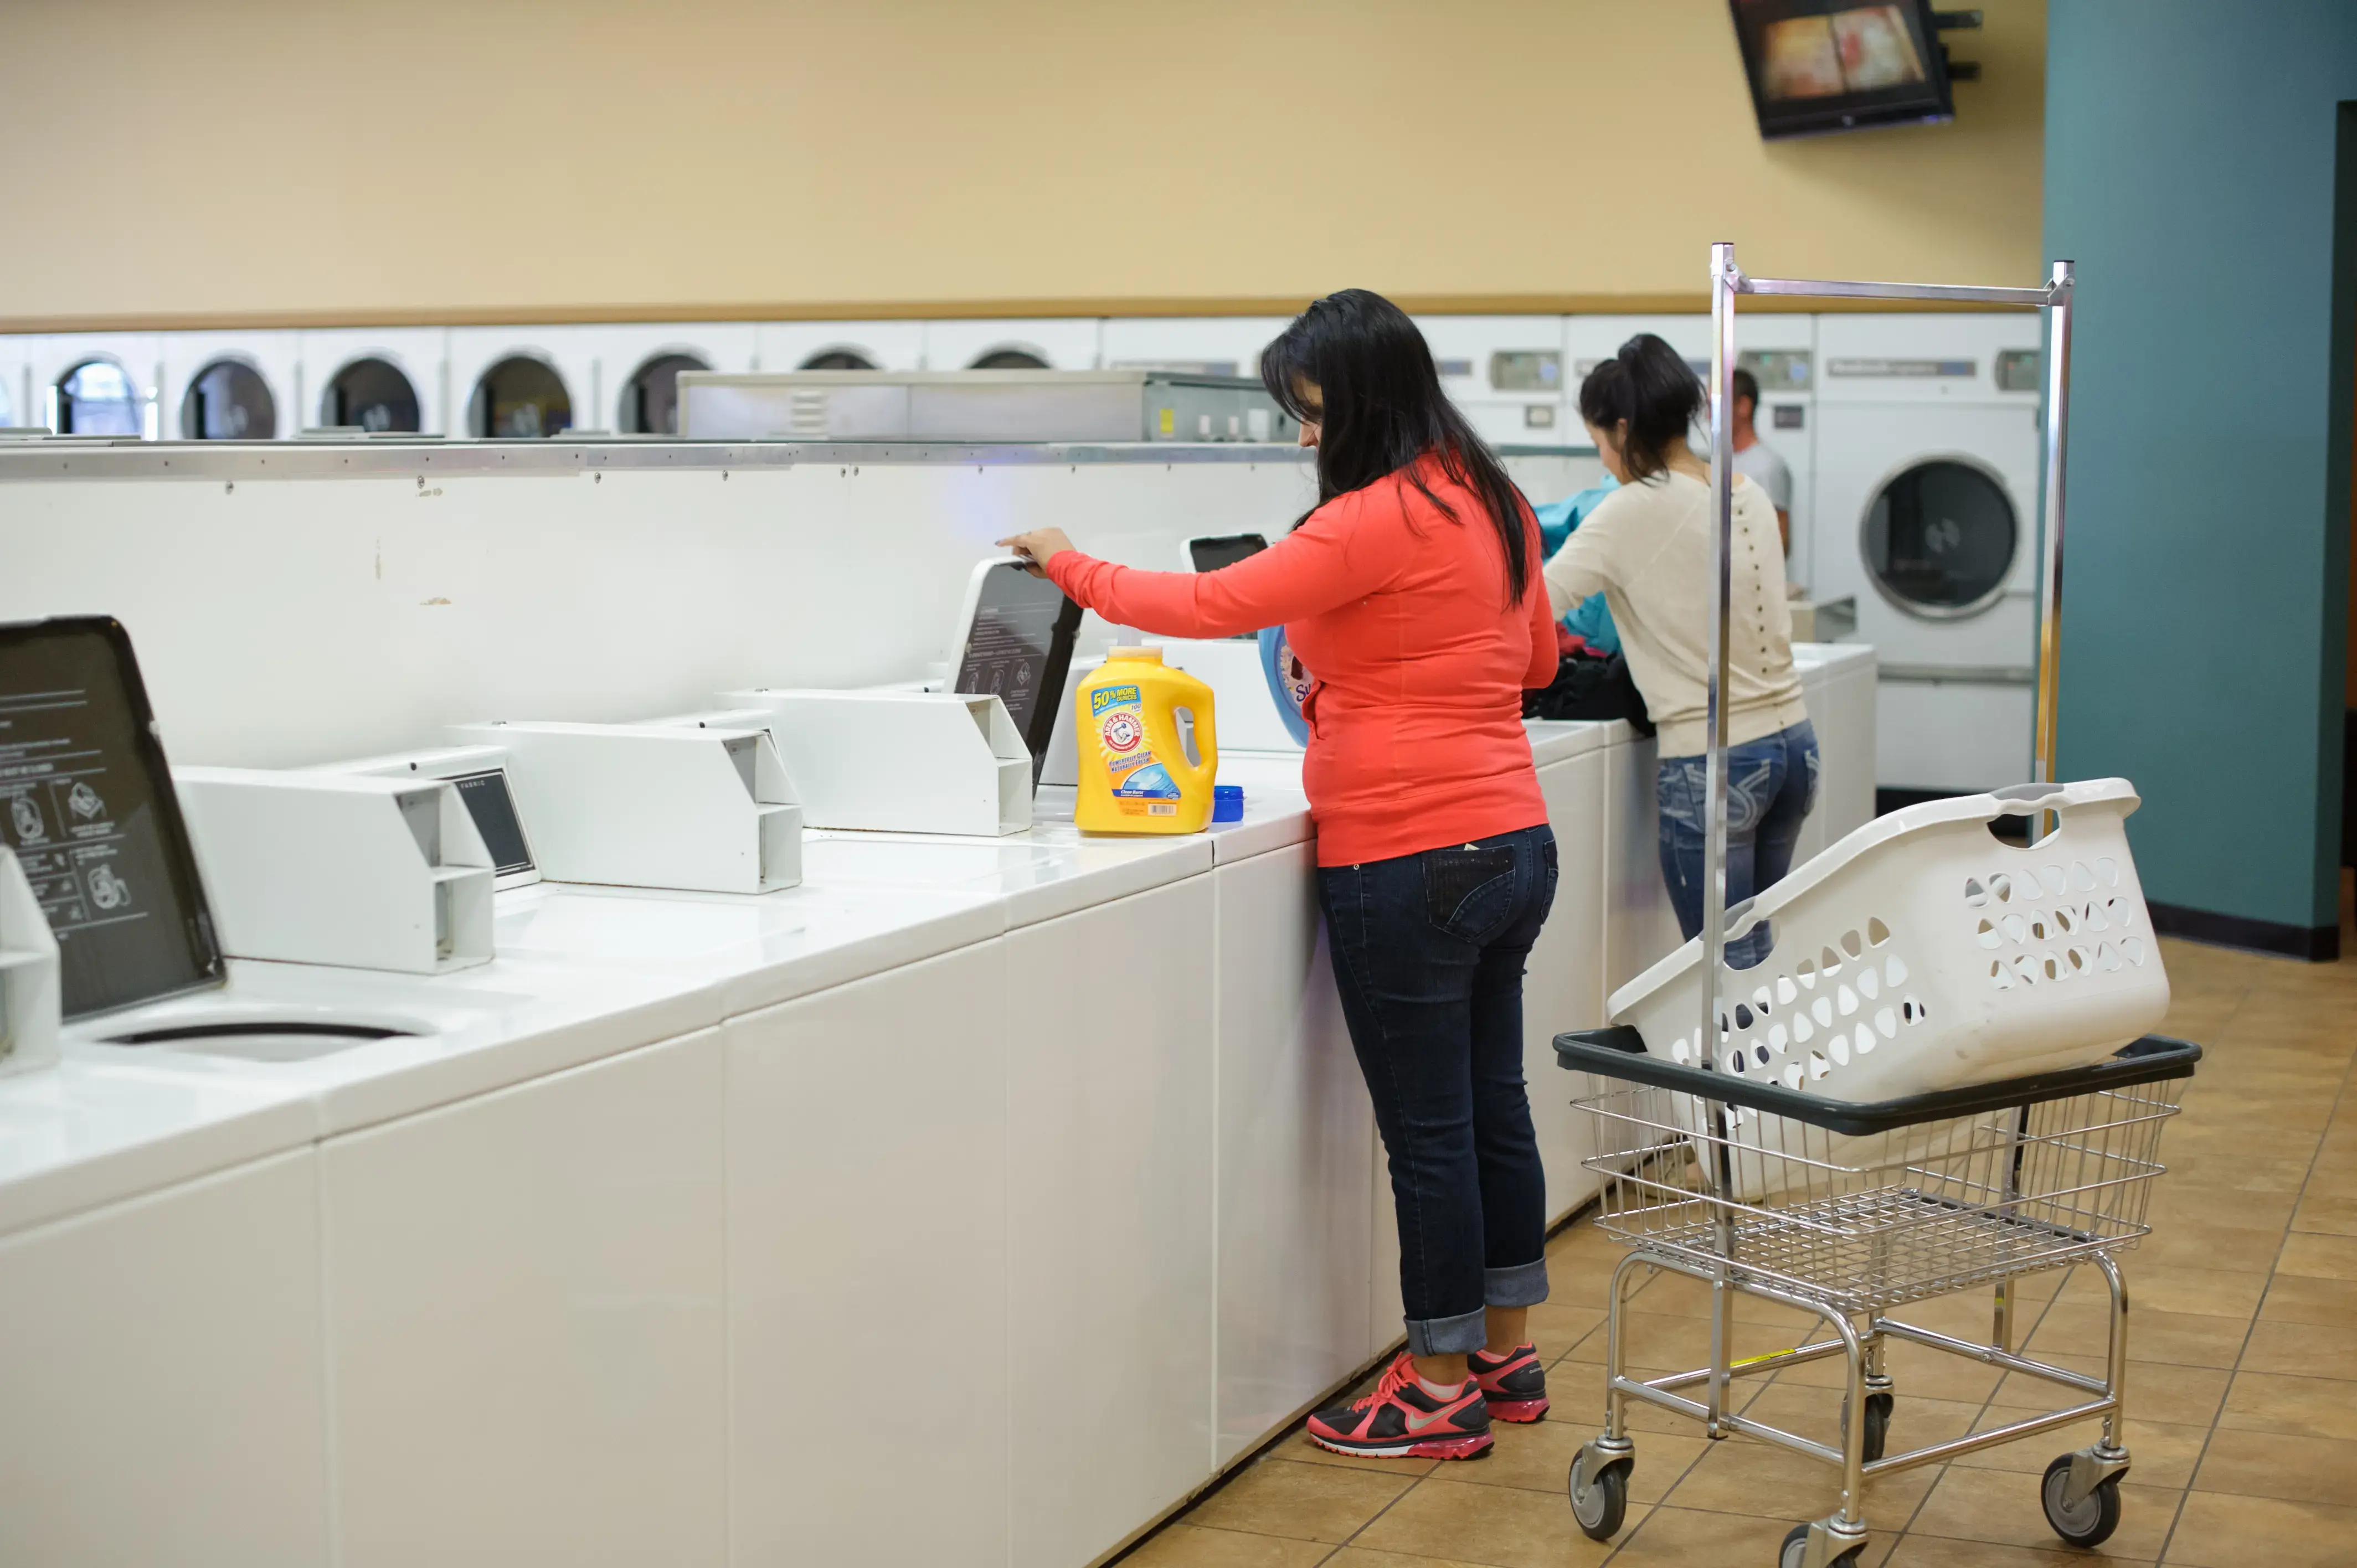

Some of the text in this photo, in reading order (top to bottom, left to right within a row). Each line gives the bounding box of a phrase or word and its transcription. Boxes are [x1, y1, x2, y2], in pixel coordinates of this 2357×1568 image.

[1093, 690, 1116, 710] 50%
[1117, 687, 1137, 697] MORE
[1105, 720, 1114, 736] ARM
[1118, 714, 1140, 737] HAMMER
[1109, 750, 1151, 767] POWERFULLY CLEAN
[1135, 757, 1150, 766] FRESH
